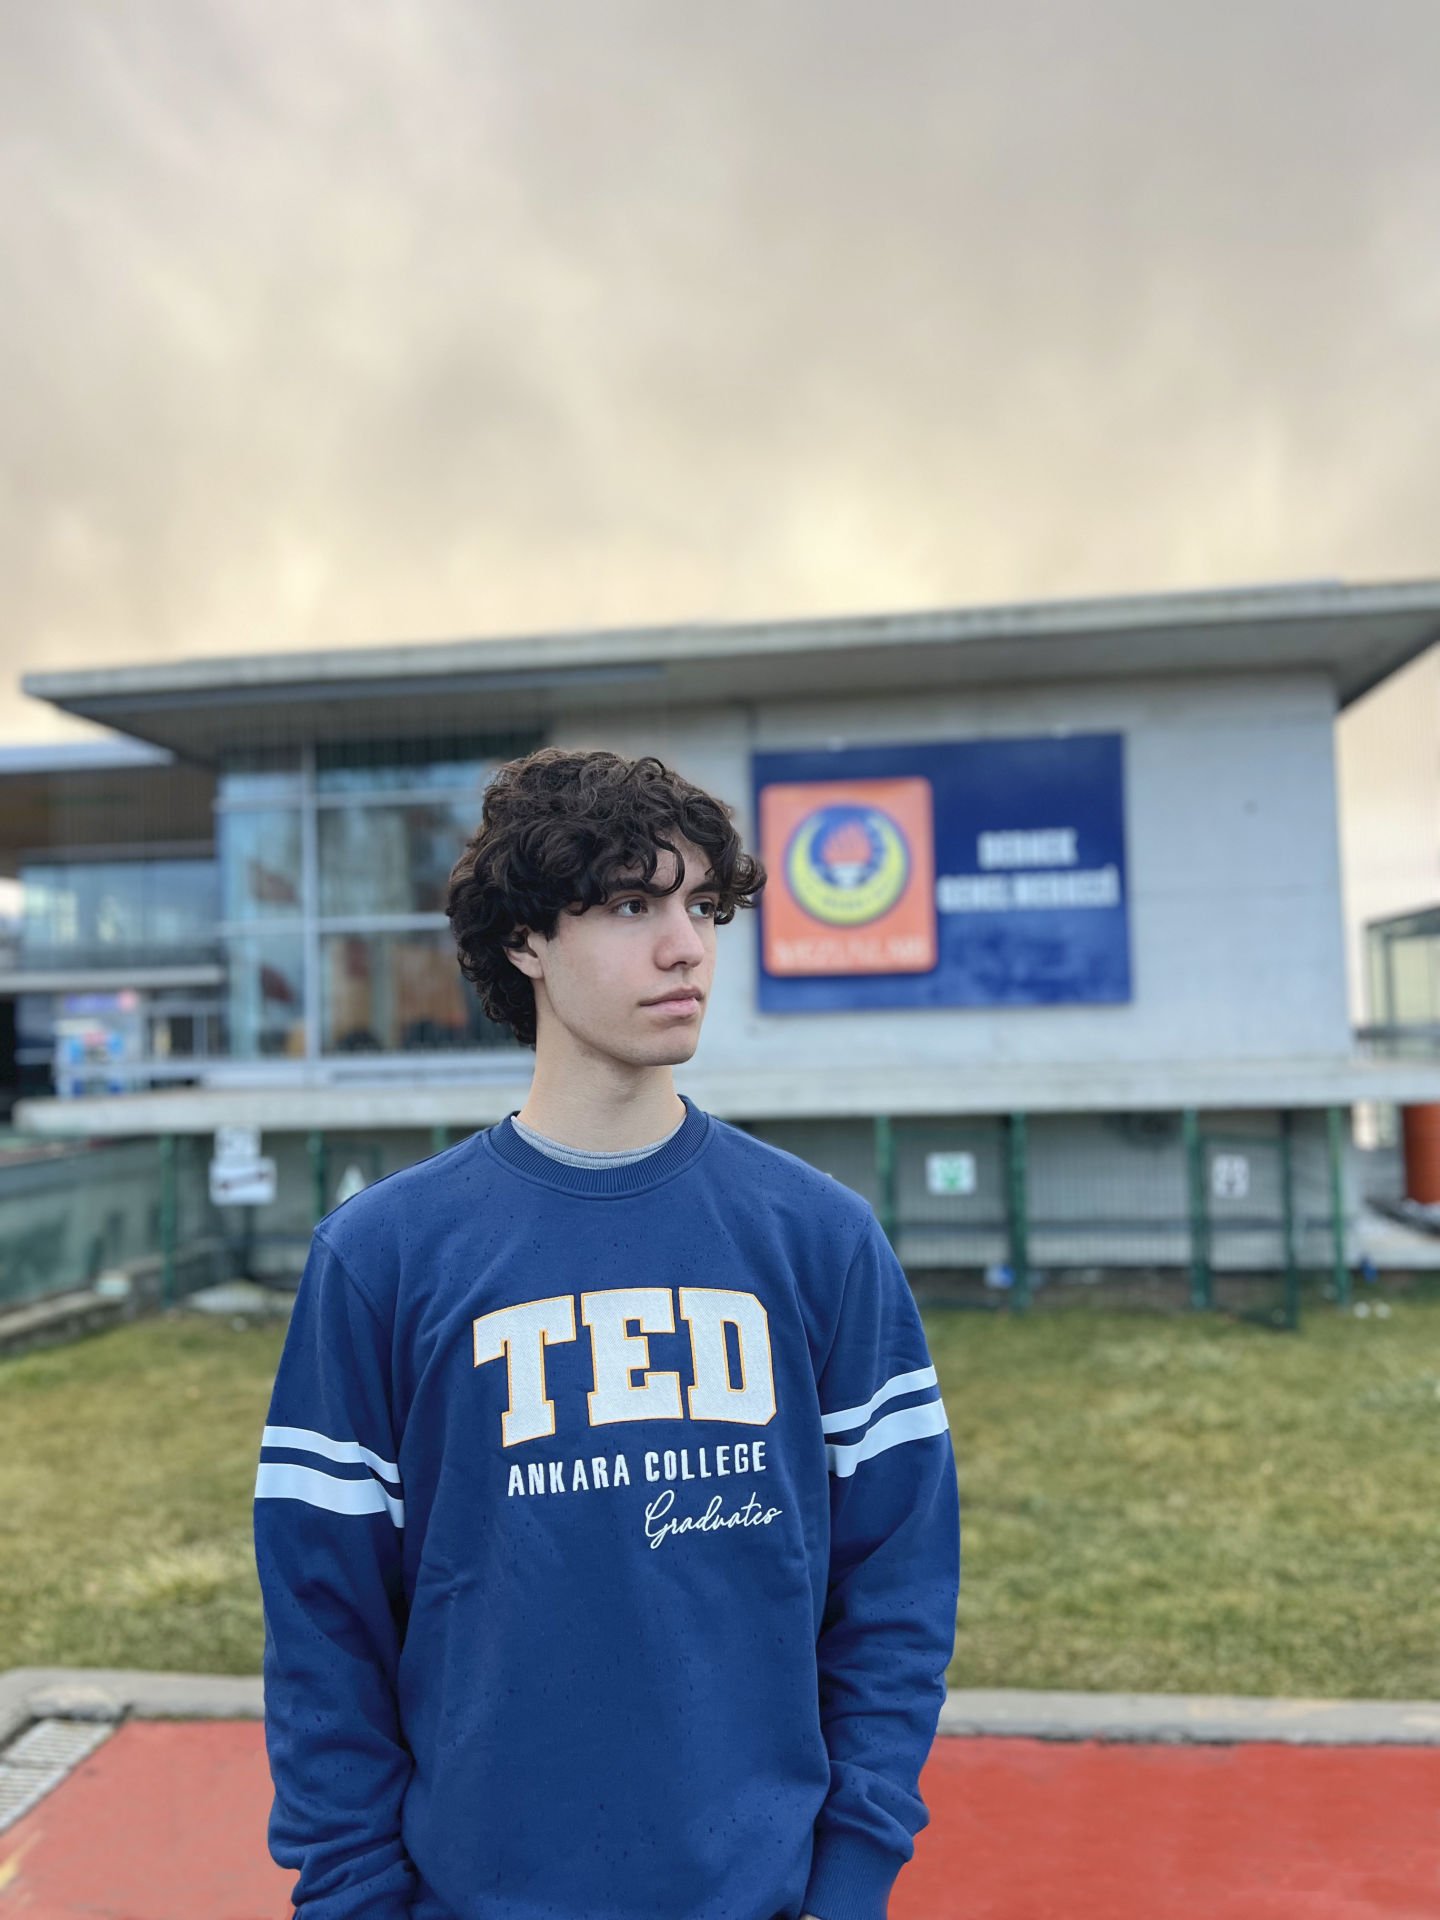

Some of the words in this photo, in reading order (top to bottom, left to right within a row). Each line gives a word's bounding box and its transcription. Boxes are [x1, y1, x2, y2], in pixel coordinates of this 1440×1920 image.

[472, 1287, 777, 1448] TED
[507, 1454, 630, 1497] ANKARA
[645, 1441, 767, 1482] COLLEGE
[644, 1489, 782, 1549] Graduates
